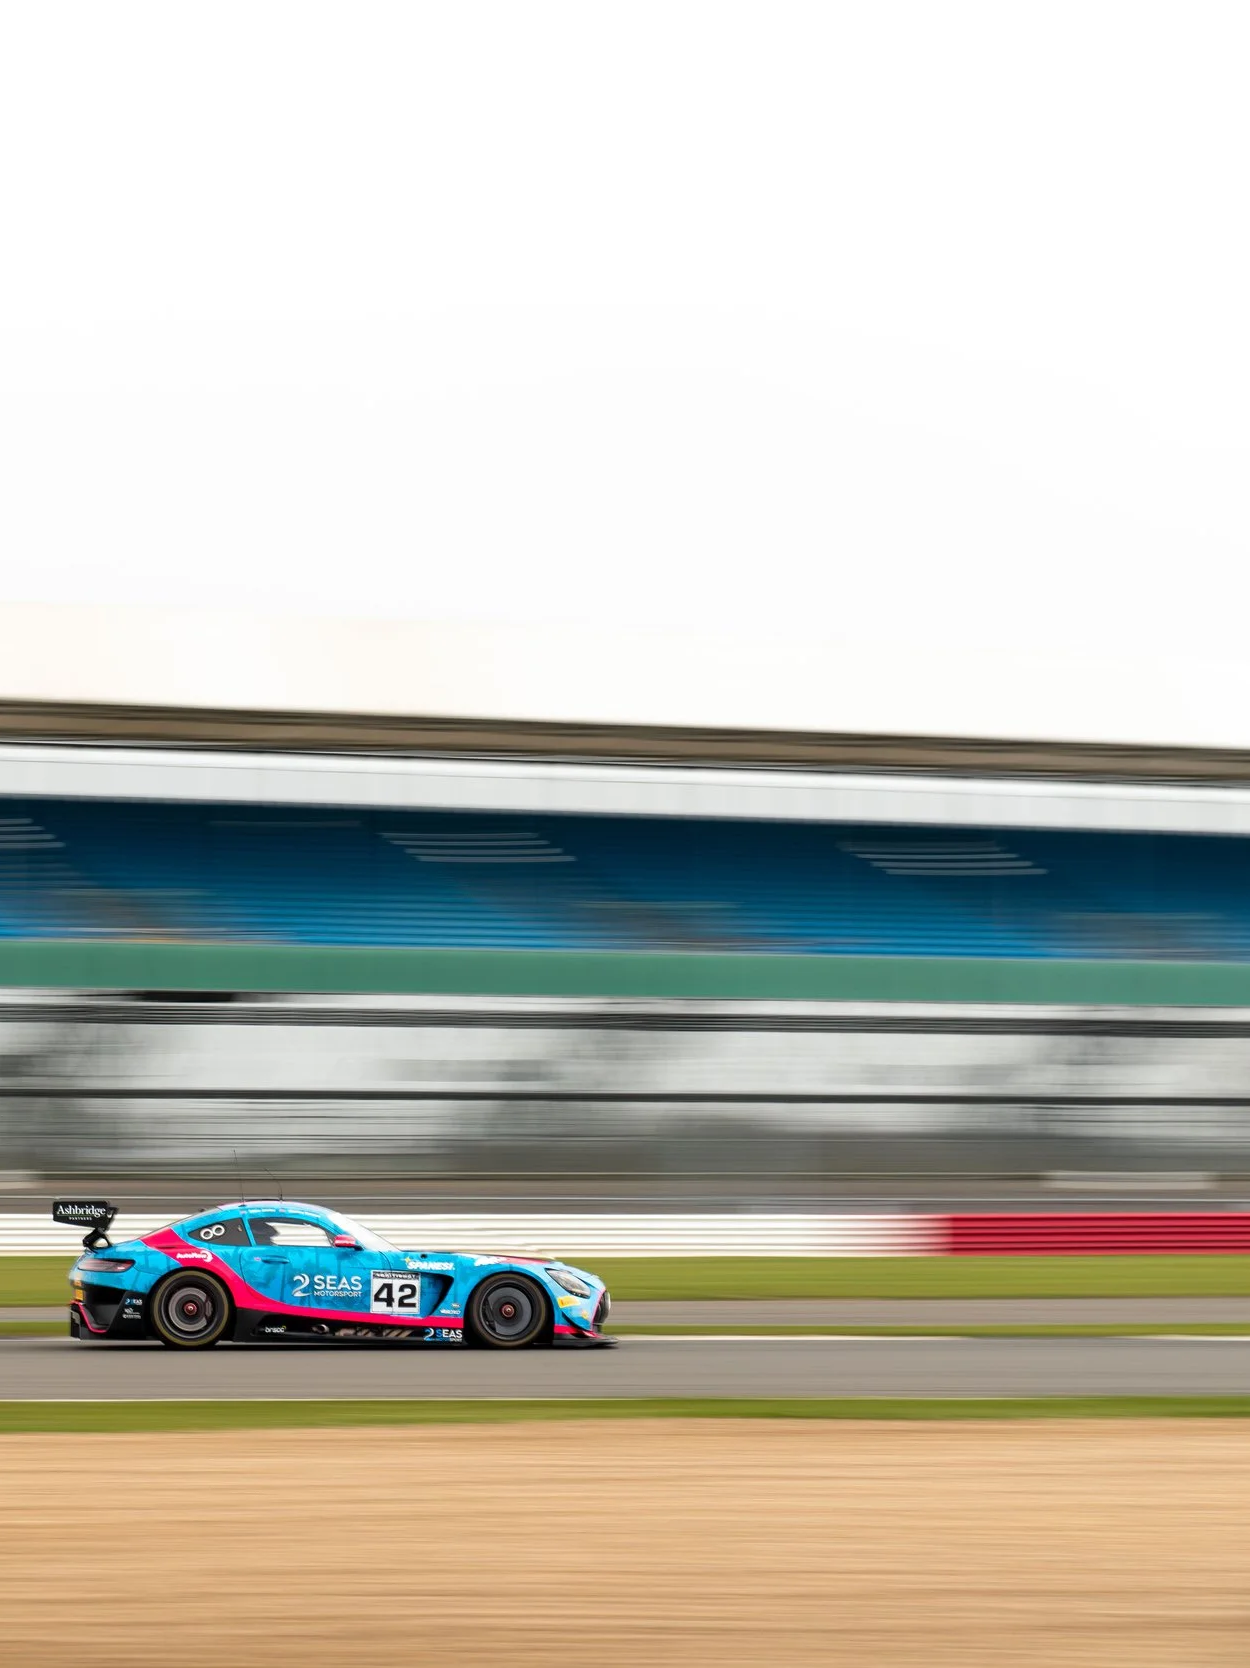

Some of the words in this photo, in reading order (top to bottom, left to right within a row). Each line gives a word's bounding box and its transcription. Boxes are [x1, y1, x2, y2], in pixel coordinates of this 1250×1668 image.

[57, 1204, 106, 1218] Ashbridge
[292, 1273, 312, 1297] 2
[313, 1275, 362, 1291] SEAS
[313, 1290, 362, 1298] MOTORSPORT
[373, 1283, 417, 1308] 42
[423, 1327, 434, 1342] 2
[435, 1328, 463, 1339] SEAS
